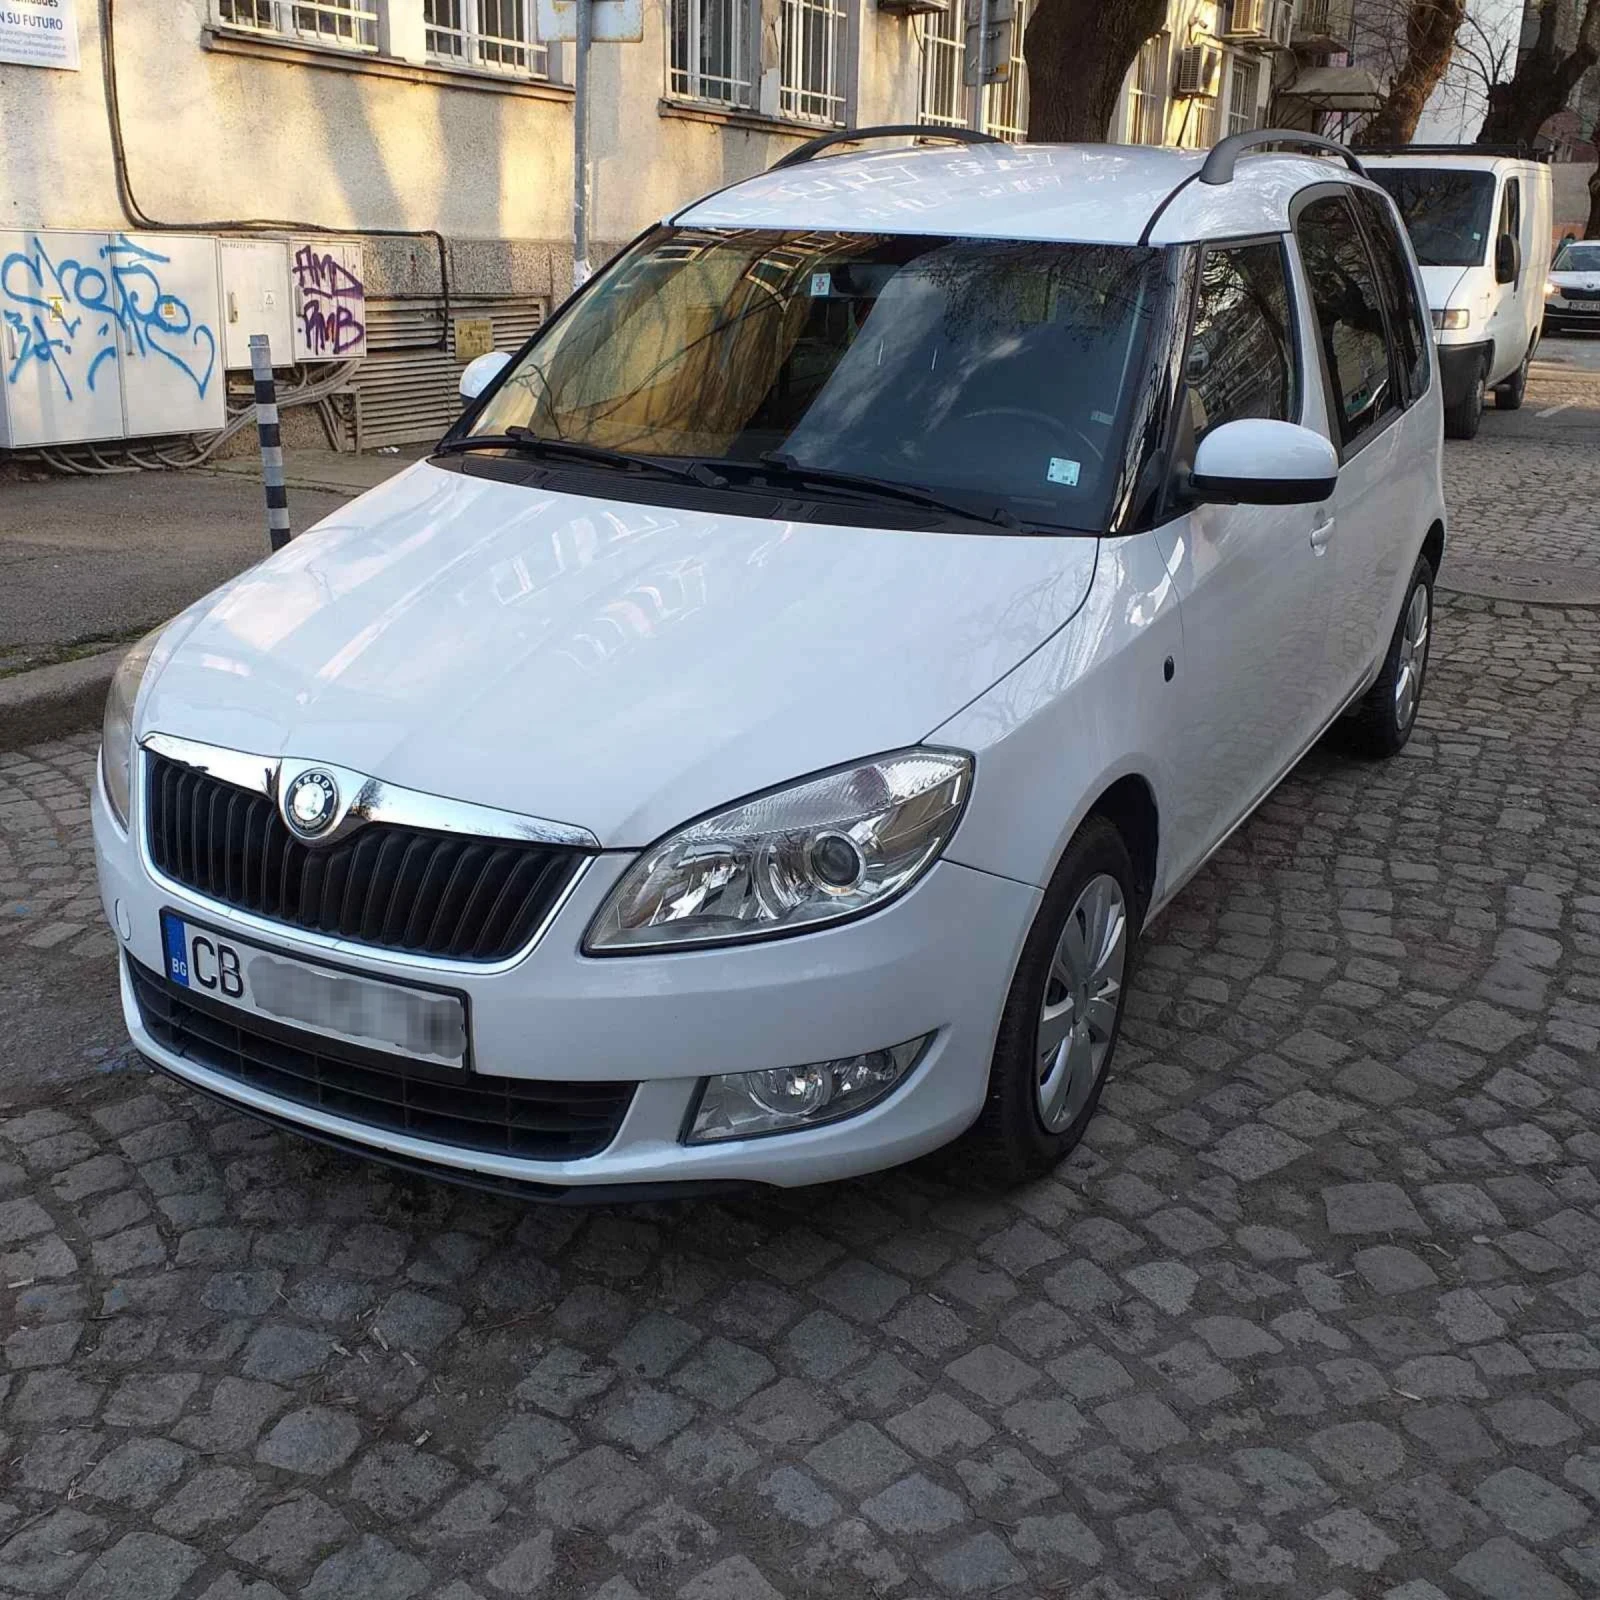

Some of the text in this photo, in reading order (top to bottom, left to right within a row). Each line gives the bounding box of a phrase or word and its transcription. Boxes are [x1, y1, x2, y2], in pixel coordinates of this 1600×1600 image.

[7, 12, 20, 24] SU
[23, 14, 63, 30] FUTURO
[172, 957, 187, 977] BG
[192, 935, 244, 998] CB
